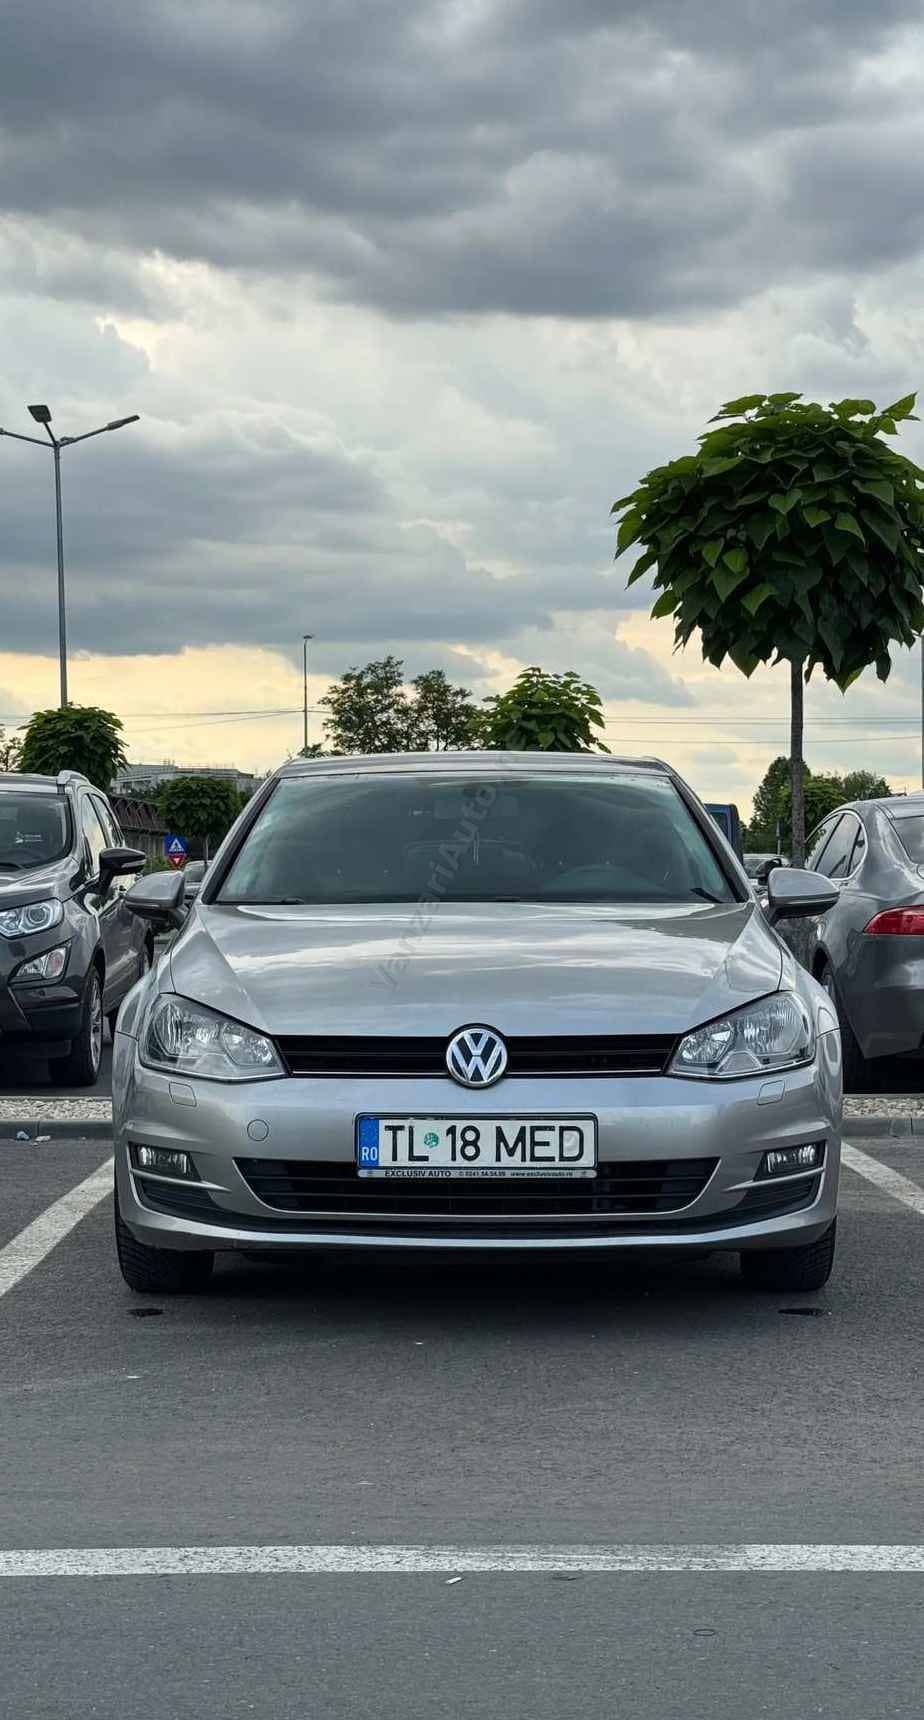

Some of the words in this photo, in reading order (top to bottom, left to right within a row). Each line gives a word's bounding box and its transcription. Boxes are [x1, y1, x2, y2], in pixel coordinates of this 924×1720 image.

[446, 1028, 507, 1088] VW
[362, 1146, 378, 1161] RO
[385, 1125, 429, 1162] TL
[446, 1125, 481, 1162] 18
[496, 1125, 584, 1162] MED
[385, 1170, 426, 1178] EXCLUSIV
[428, 1170, 452, 1178] AUTO
